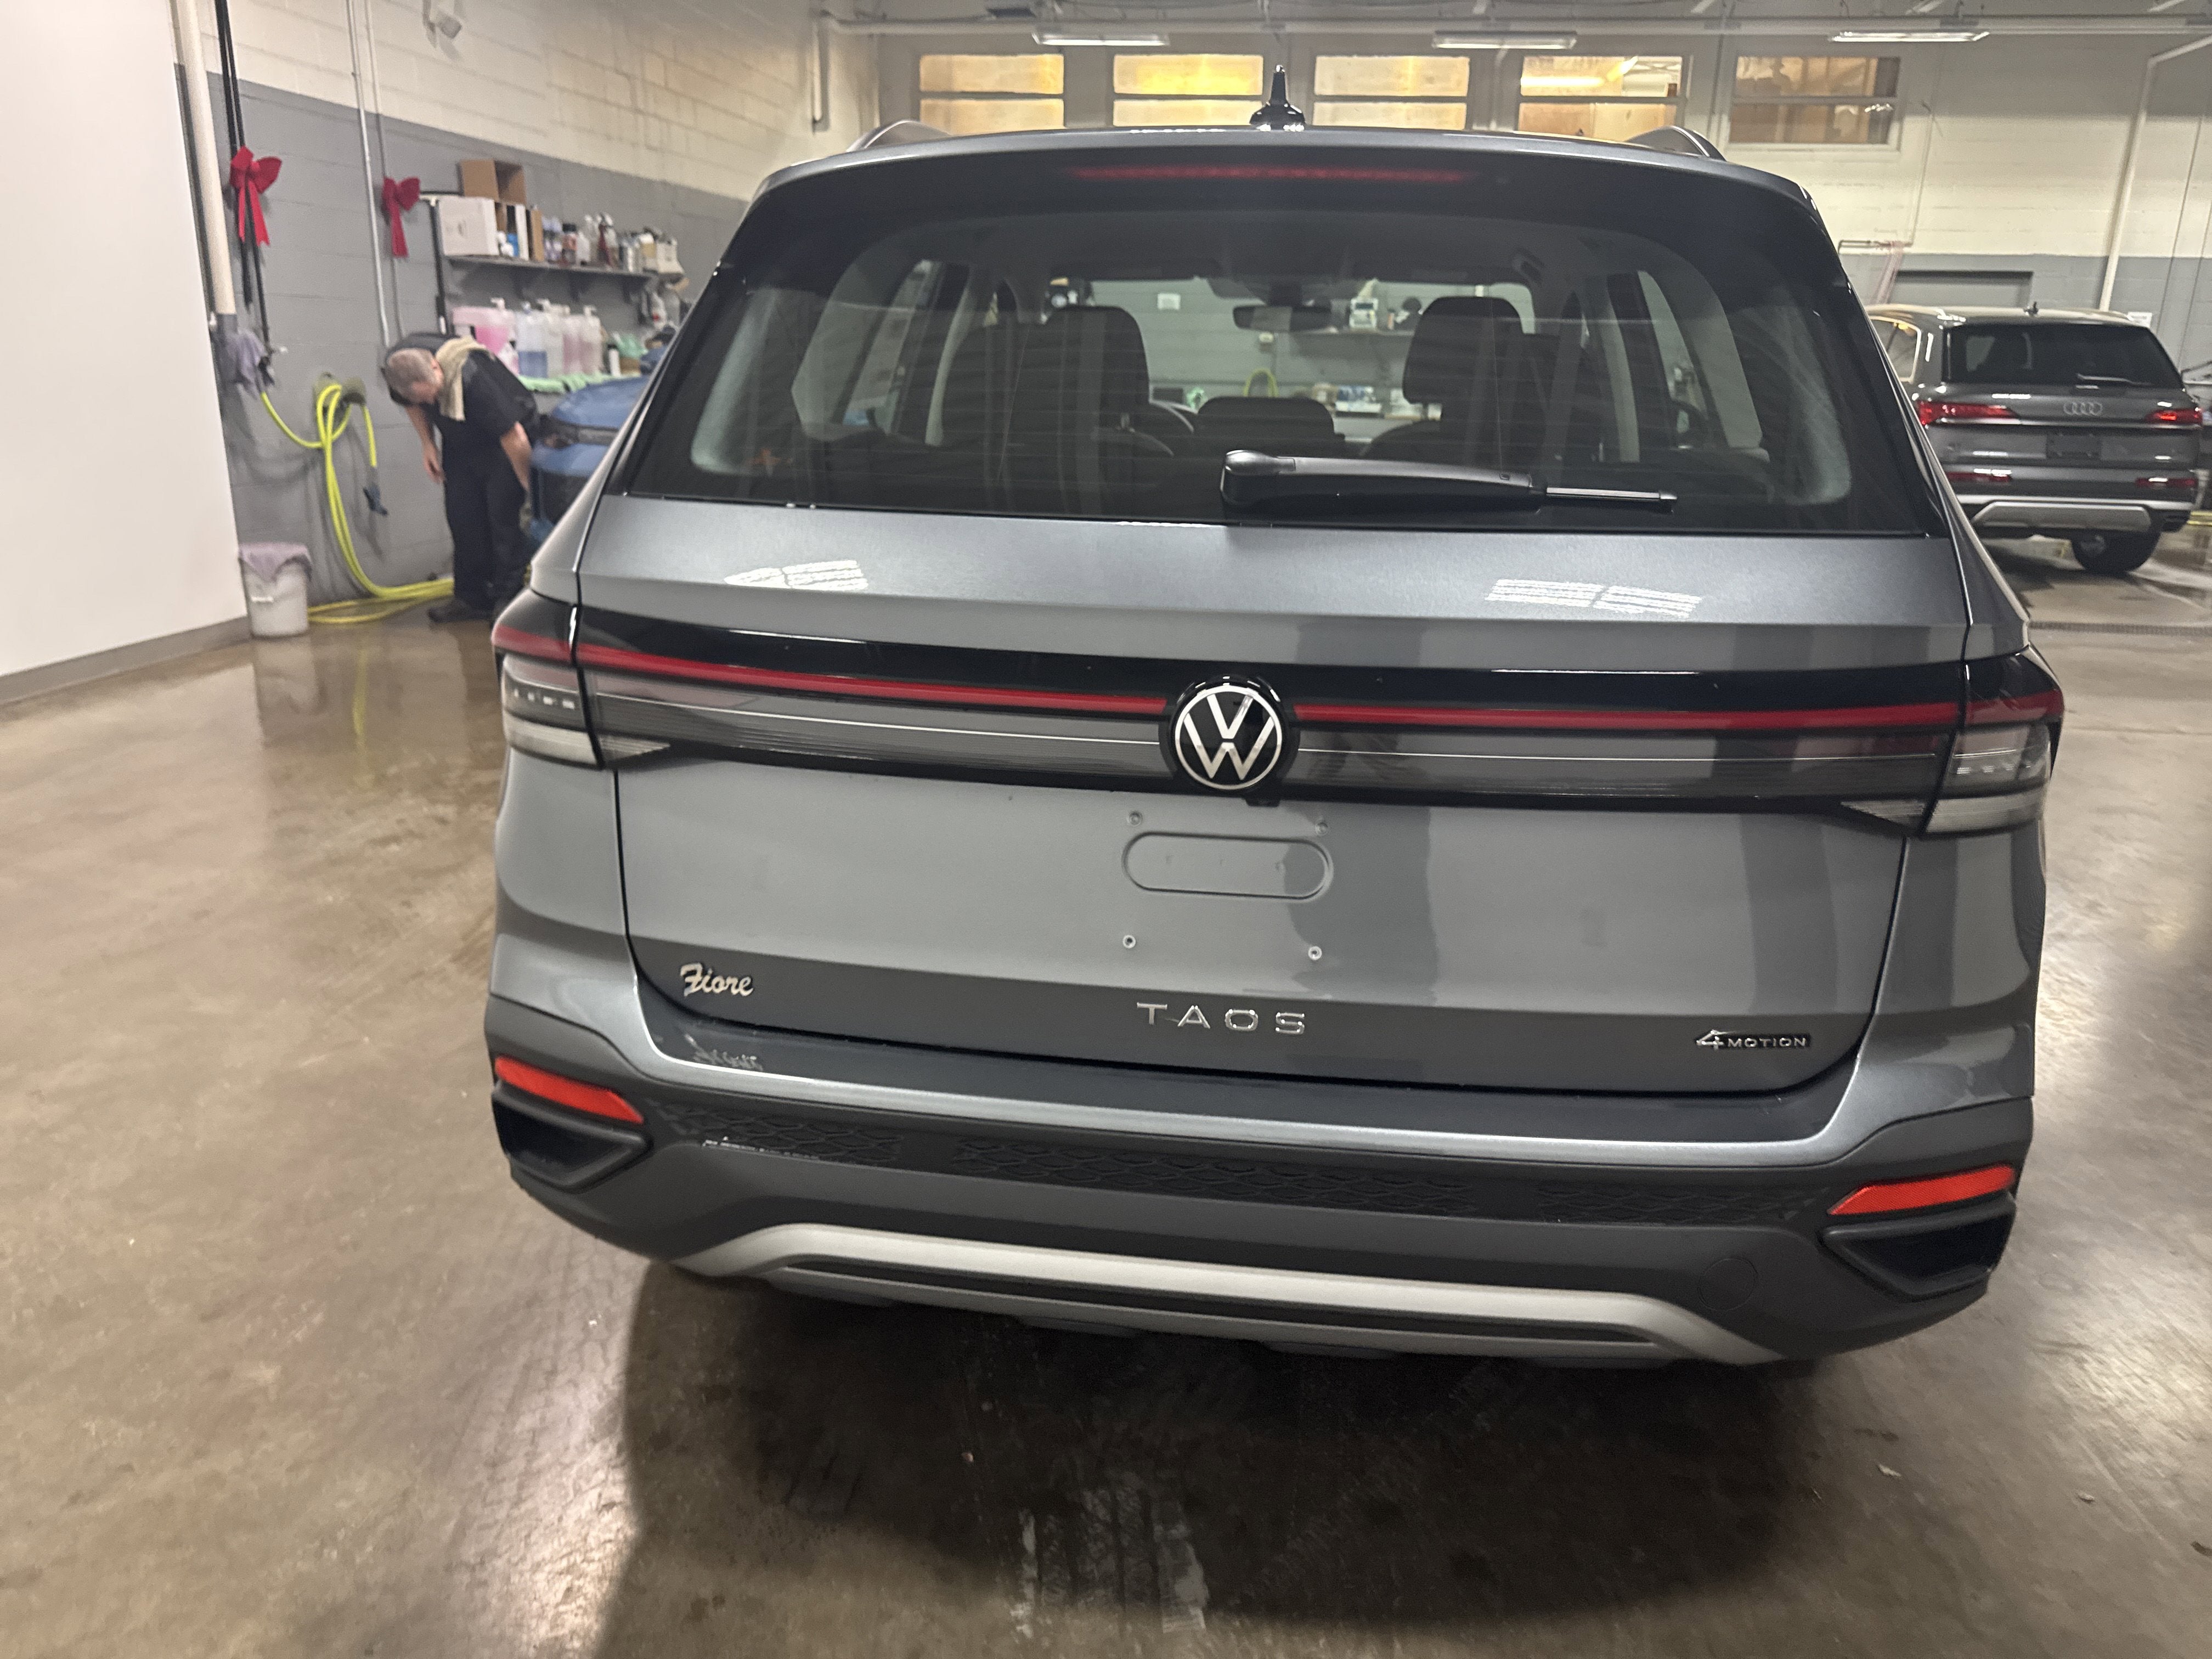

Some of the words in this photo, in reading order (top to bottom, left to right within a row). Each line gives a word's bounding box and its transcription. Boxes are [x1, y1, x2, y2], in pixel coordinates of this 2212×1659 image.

[1182, 692, 1276, 781] VW
[680, 962, 753, 997] Fiore
[1136, 1002, 1305, 1035] TAOS
[1696, 1029, 1807, 1050] 4MOTION
